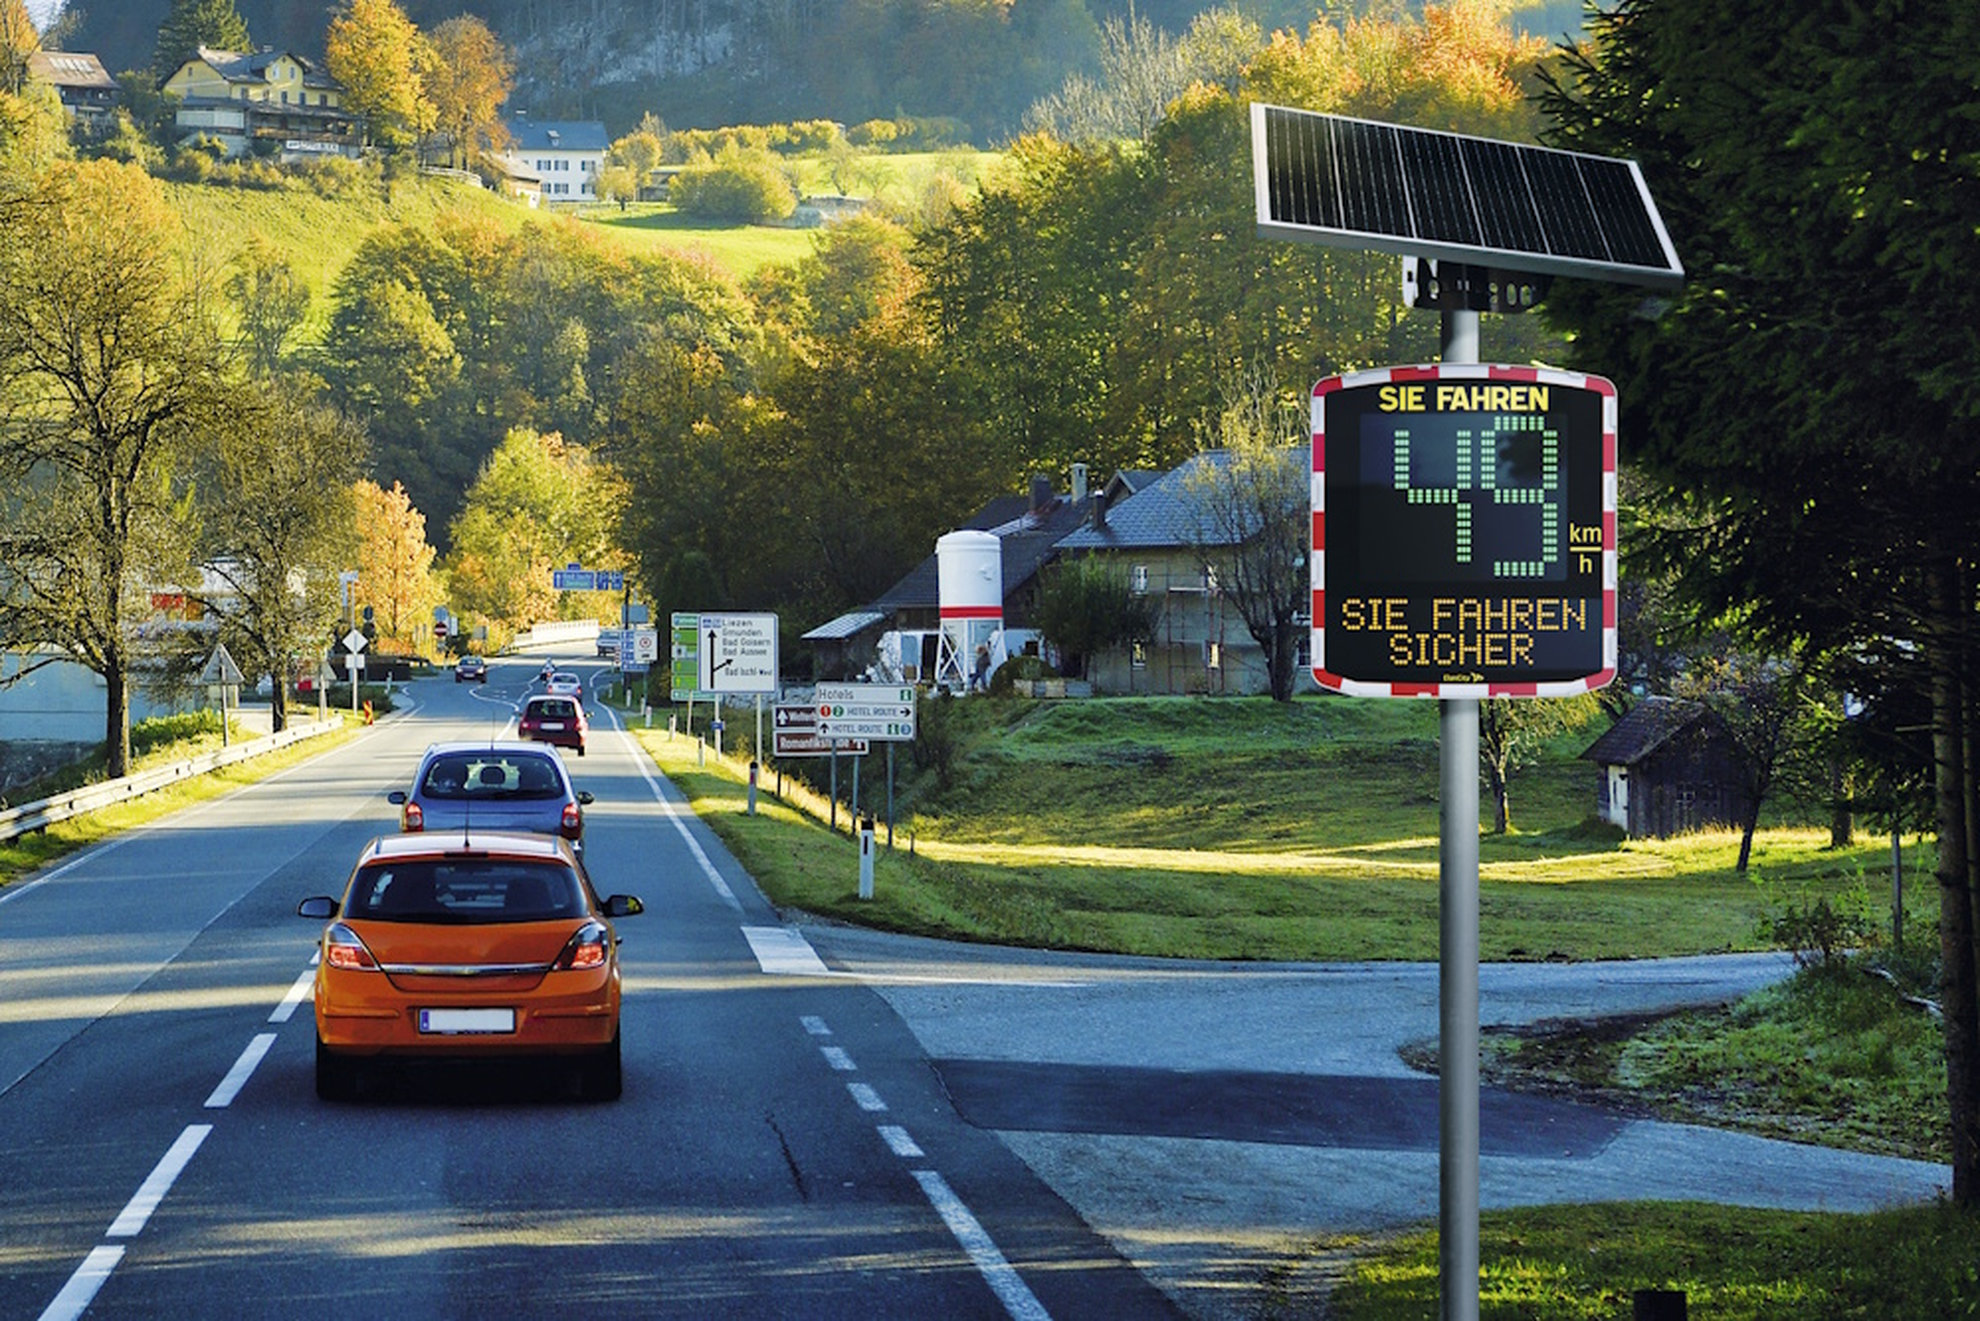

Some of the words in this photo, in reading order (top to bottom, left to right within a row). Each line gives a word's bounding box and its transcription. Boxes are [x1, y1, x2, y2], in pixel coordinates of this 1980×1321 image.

[1379, 386, 1425, 411] SIE
[1437, 386, 1549, 411] FAHREN
[1394, 416, 1558, 577] 49
[1569, 522, 1602, 543] km
[1342, 598, 1408, 631] SIE
[1433, 598, 1586, 631] FAHREN
[722, 619, 753, 627] Liezen
[722, 638, 738, 646] Bad
[722, 648, 738, 656] Bad
[1389, 633, 1534, 665] SICHER
[819, 688, 854, 700] Hotels
[848, 707, 872, 717] HOTEL
[873, 707, 898, 717] ROUTE
[832, 723, 857, 733] HOTEL
[858, 723, 883, 733] ROUTE
